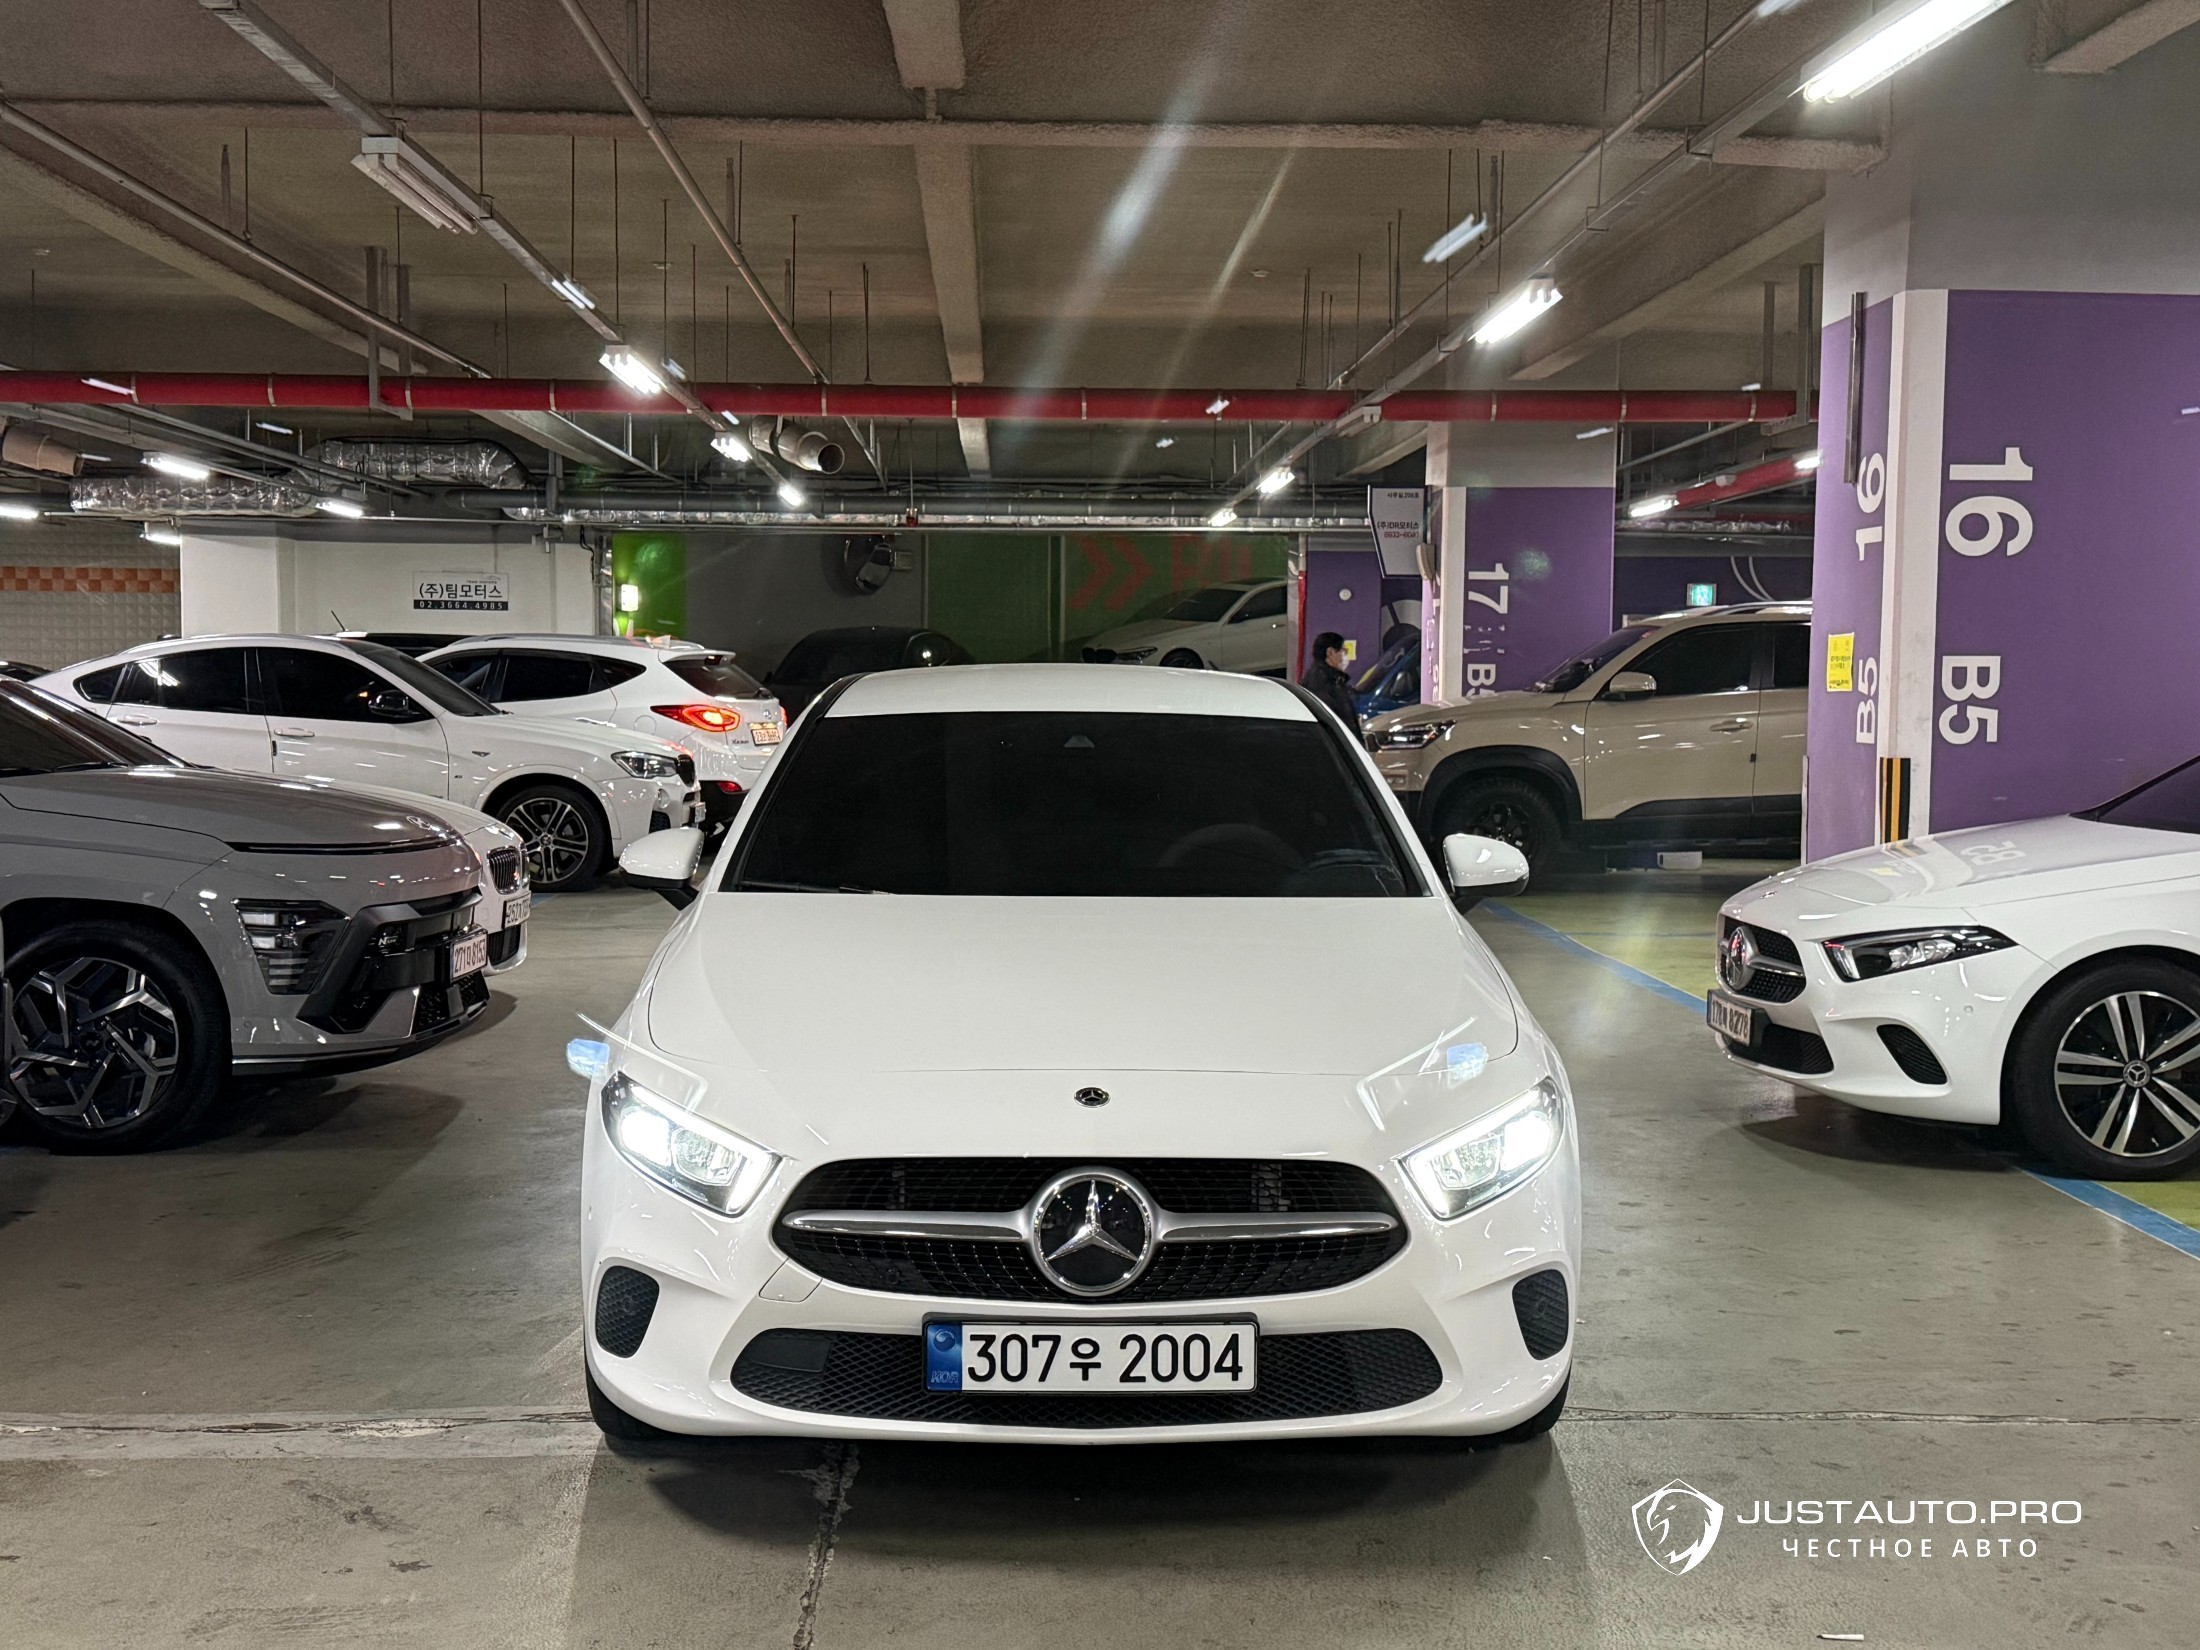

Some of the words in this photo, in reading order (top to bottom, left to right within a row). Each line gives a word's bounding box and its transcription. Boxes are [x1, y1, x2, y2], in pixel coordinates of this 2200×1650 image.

[1856, 452, 1885, 561] 16
[1945, 447, 2034, 557] 16
[419, 582, 502, 599] (주)팀모터스
[1468, 563, 1510, 614] 17
[1855, 656, 1878, 744] B5
[1939, 655, 2001, 745] B5
[967, 1333, 1102, 1383] 307우
[1119, 1333, 1243, 1383] 2004
